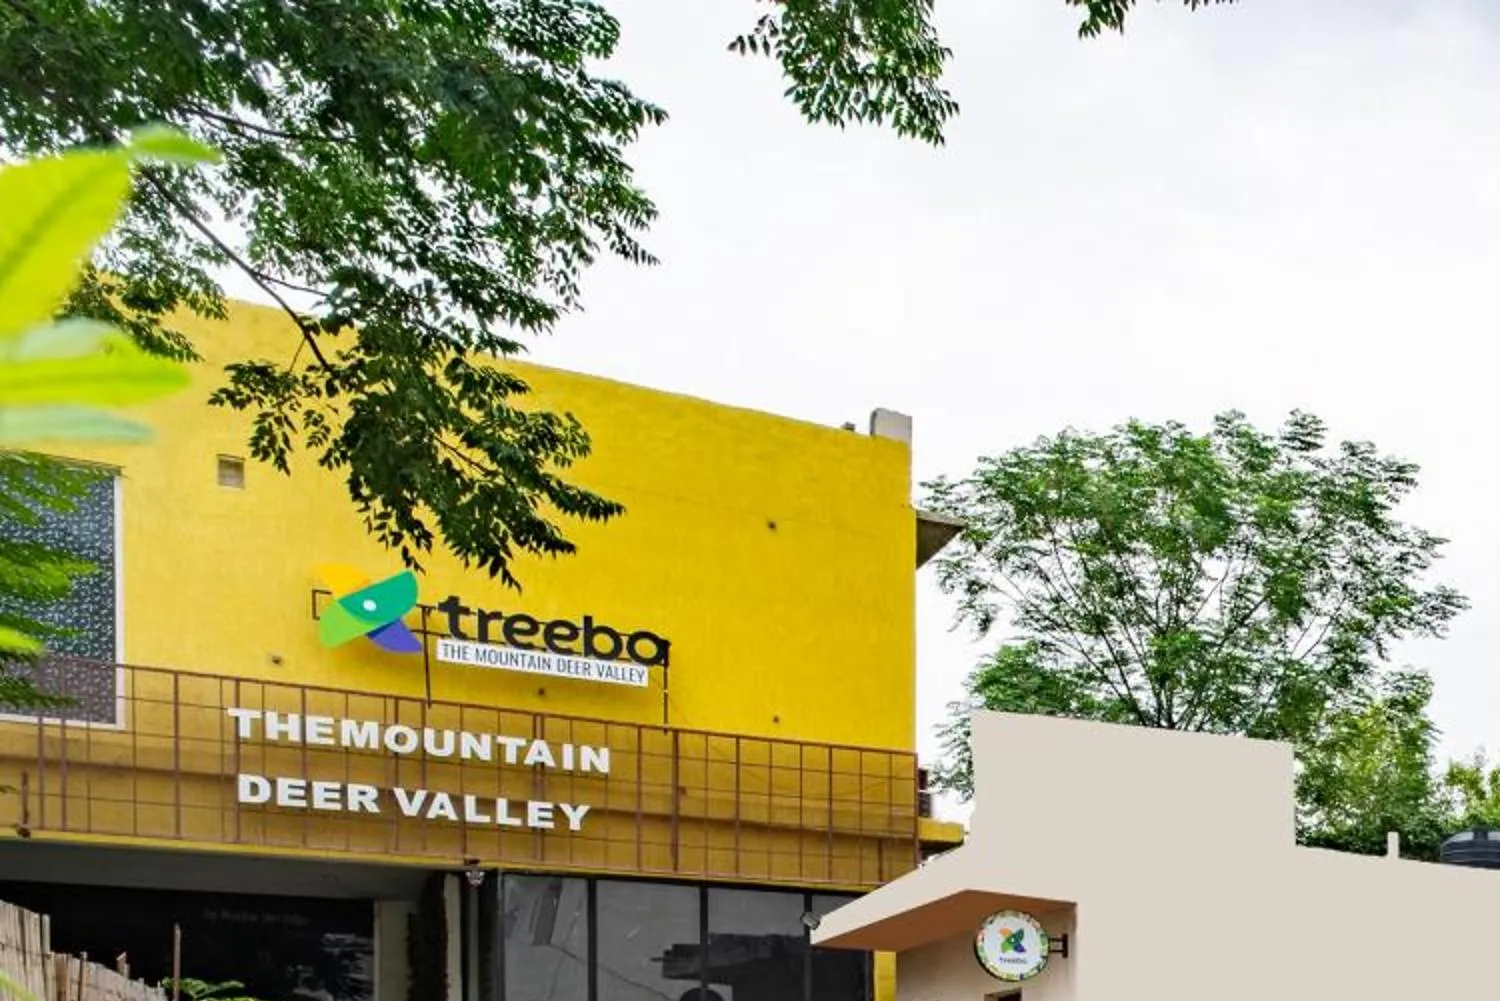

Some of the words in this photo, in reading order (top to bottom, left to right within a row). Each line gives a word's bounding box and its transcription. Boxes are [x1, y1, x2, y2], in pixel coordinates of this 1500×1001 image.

[441, 643, 470, 662] THE
[475, 647, 551, 672] MOUNTAIN
[557, 658, 592, 677] DEER
[596, 664, 645, 683] VALLEY
[237, 774, 380, 814] DEER
[393, 787, 592, 832] VALLEY
